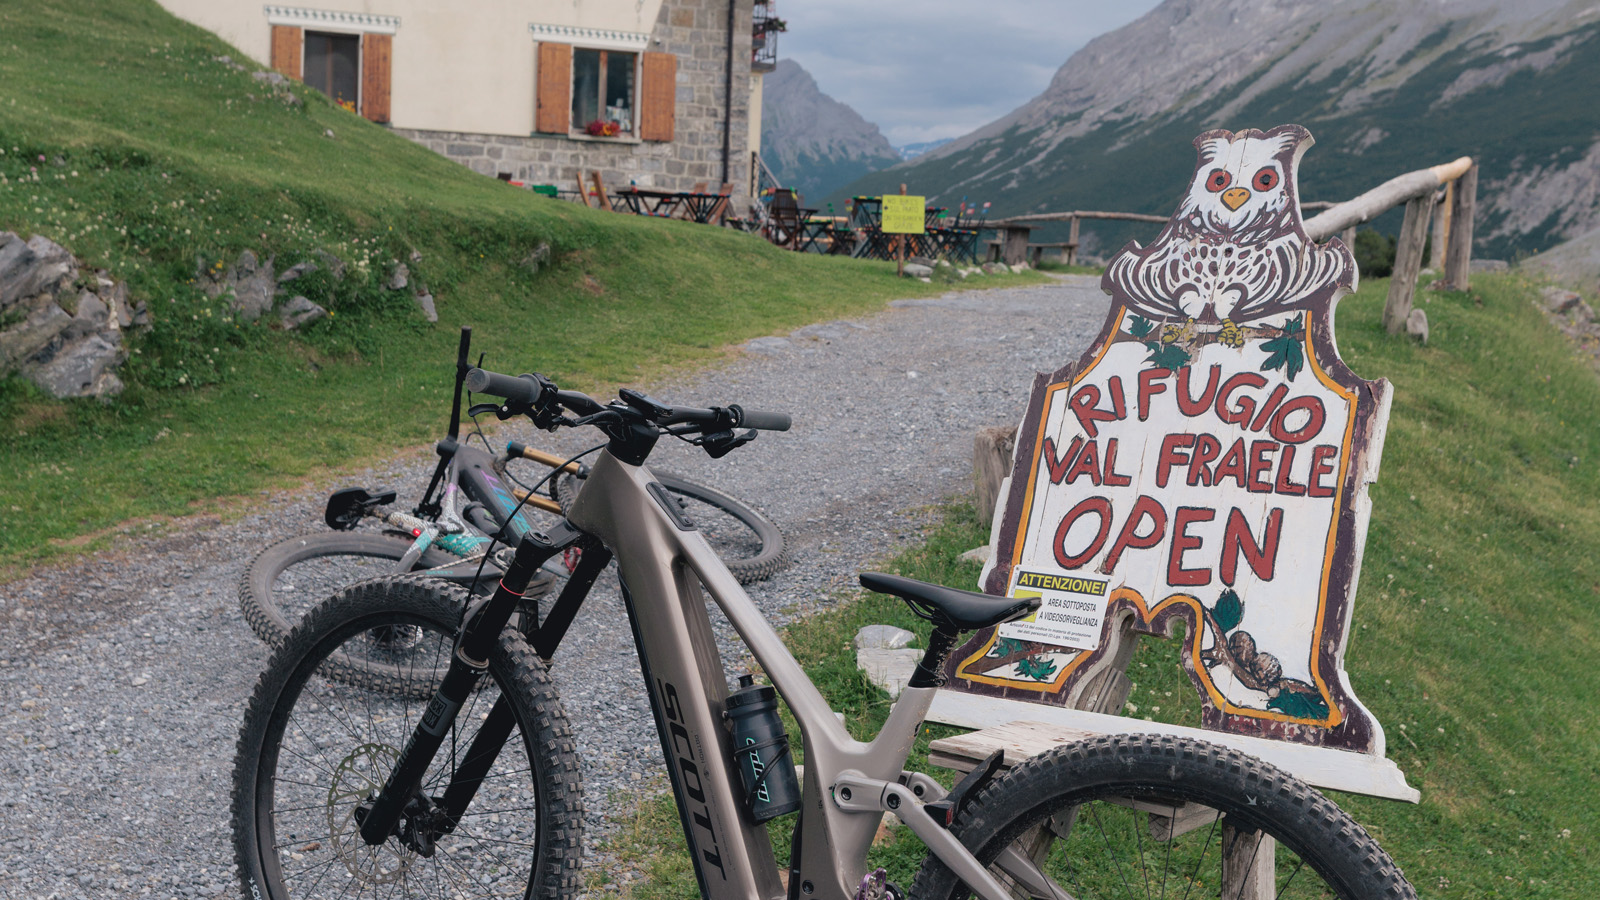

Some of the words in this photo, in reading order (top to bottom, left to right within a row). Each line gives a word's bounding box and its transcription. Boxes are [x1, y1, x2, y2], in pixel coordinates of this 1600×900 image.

[1069, 364, 1327, 444] RIFUGIO
[1043, 434, 1132, 487] VAL
[1155, 432, 1338, 498] FRAELE
[1052, 495, 1285, 588] OPEN
[1019, 573, 1106, 595] ATTENZIONE!
[1048, 598, 1062, 608] AREA
[1062, 599, 1097, 612] SOTTOPOSTA
[1044, 611, 1098, 627] VIDEOSORVEGLIANZA
[657, 678, 727, 881] SCOTT
